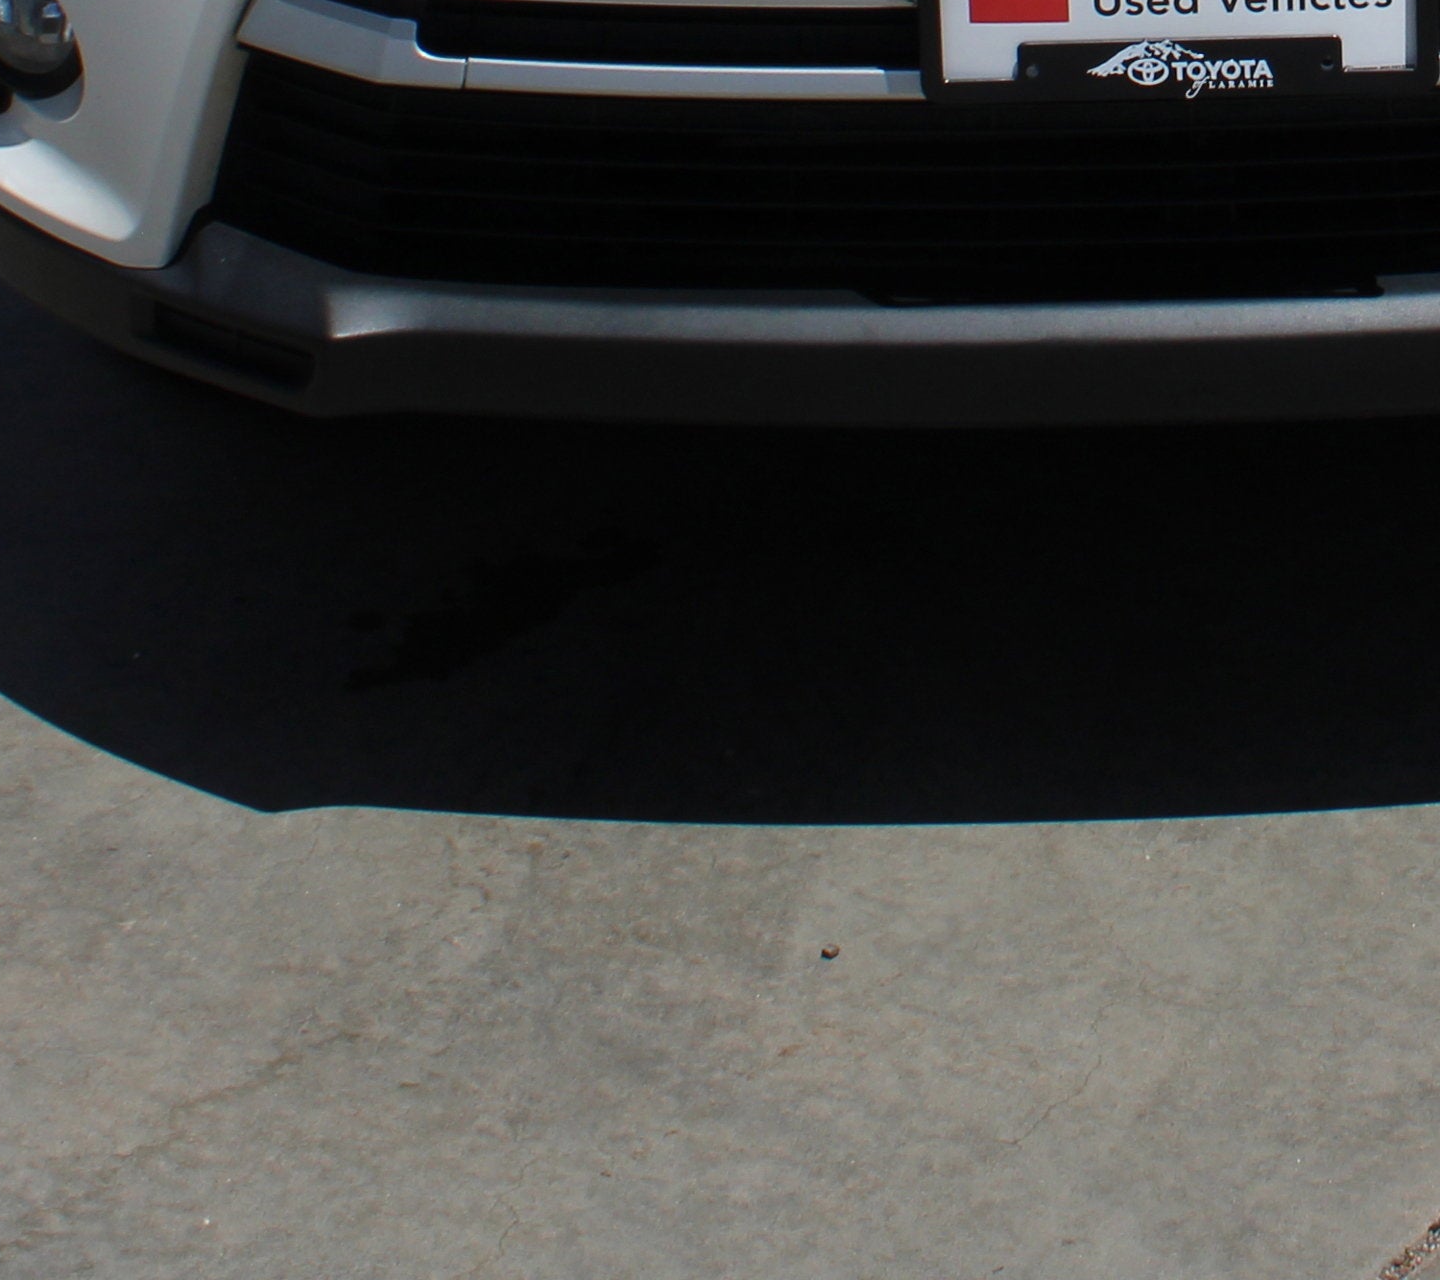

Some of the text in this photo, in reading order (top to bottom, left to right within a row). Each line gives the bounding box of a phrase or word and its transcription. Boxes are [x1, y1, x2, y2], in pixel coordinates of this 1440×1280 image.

[1171, 58, 1274, 81] TOYOTA
[1185, 76, 1274, 99] of LARAMIE
